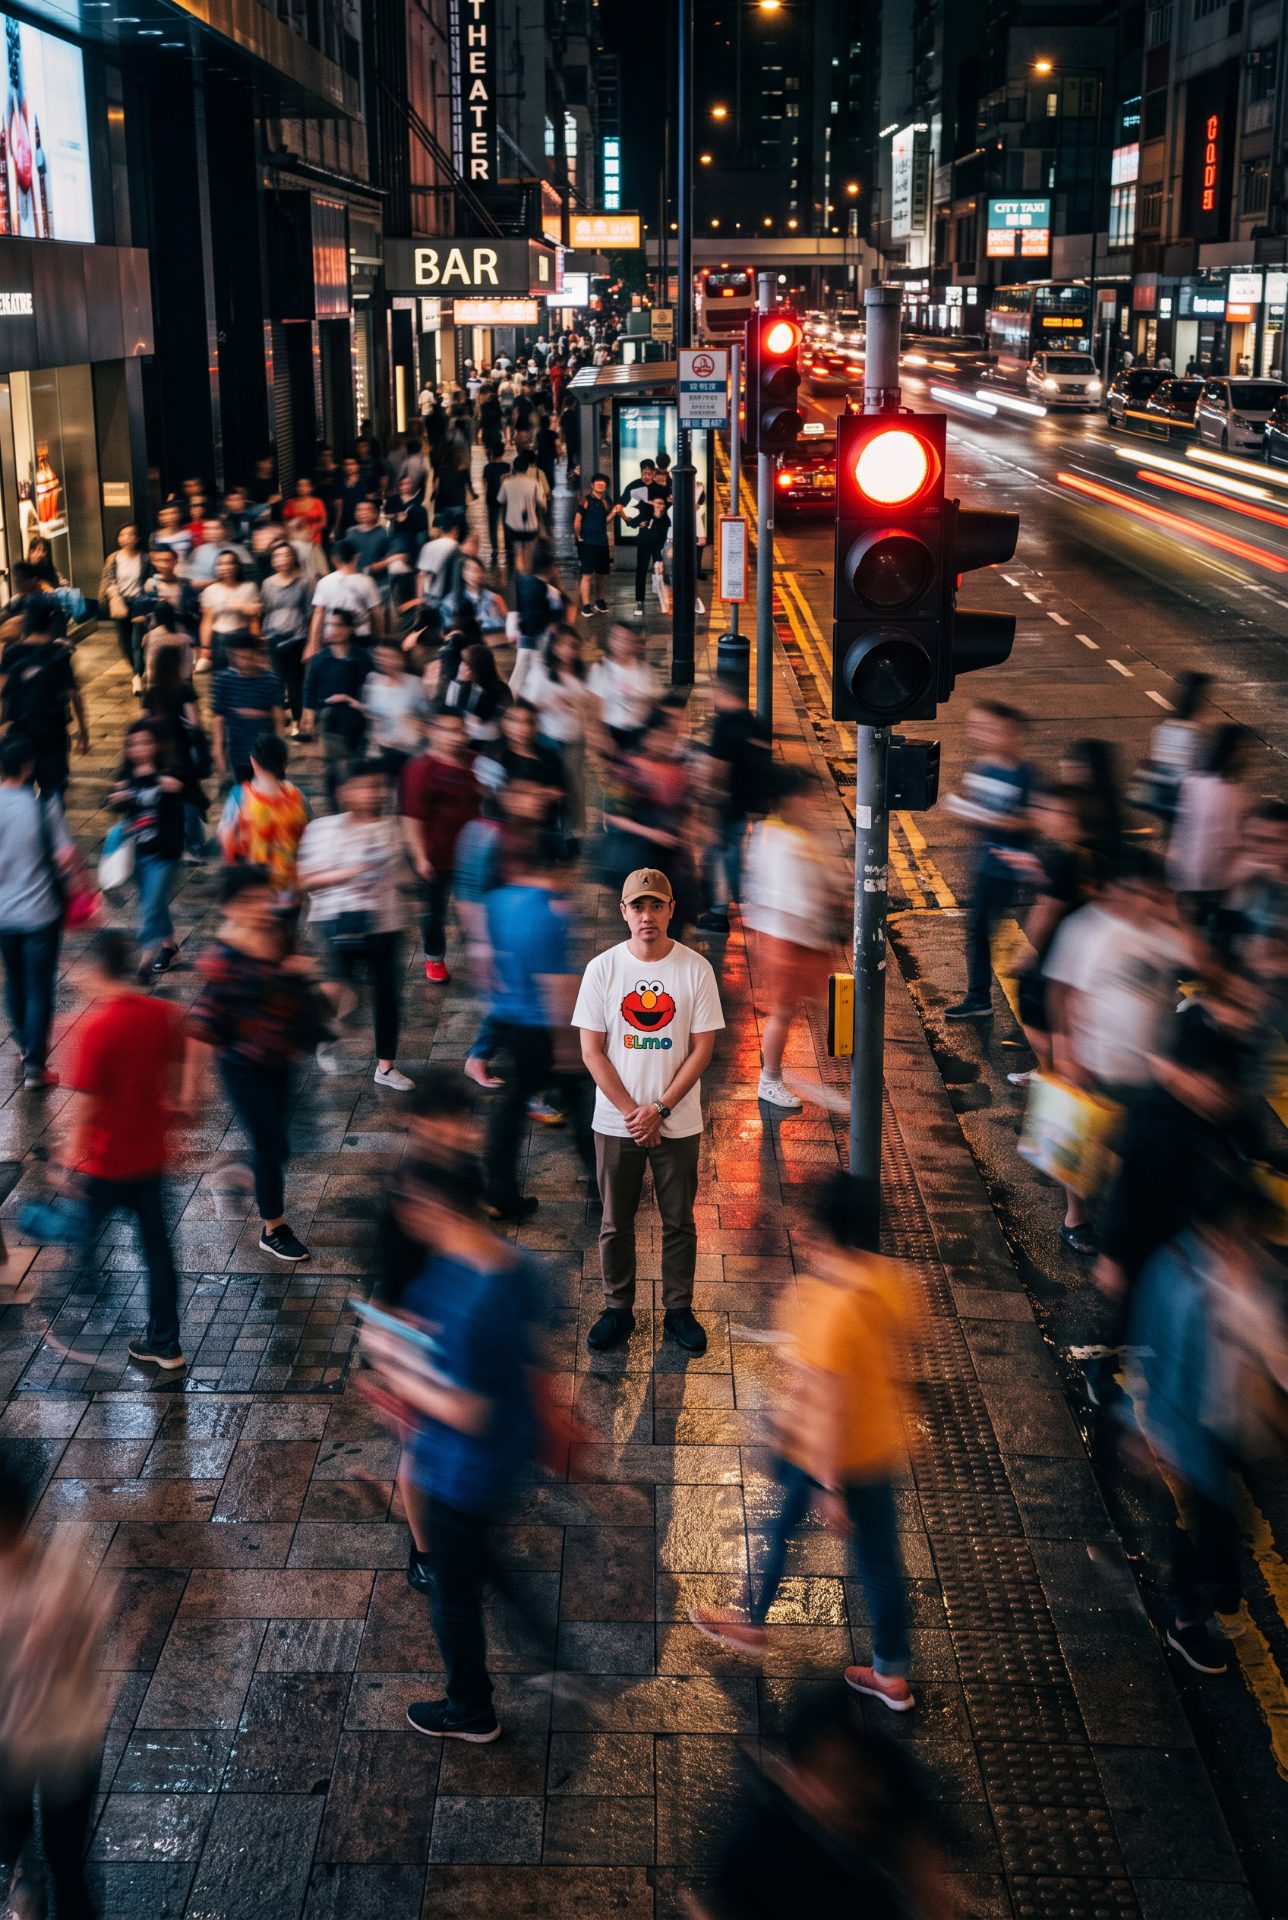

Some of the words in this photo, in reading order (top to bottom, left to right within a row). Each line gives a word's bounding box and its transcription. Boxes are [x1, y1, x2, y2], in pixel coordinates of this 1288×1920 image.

[467, 0, 489, 180] THEATER
[994, 202, 1018, 213] CITY
[1020, 202, 1046, 213] TAXI
[414, 247, 499, 285] BAR
